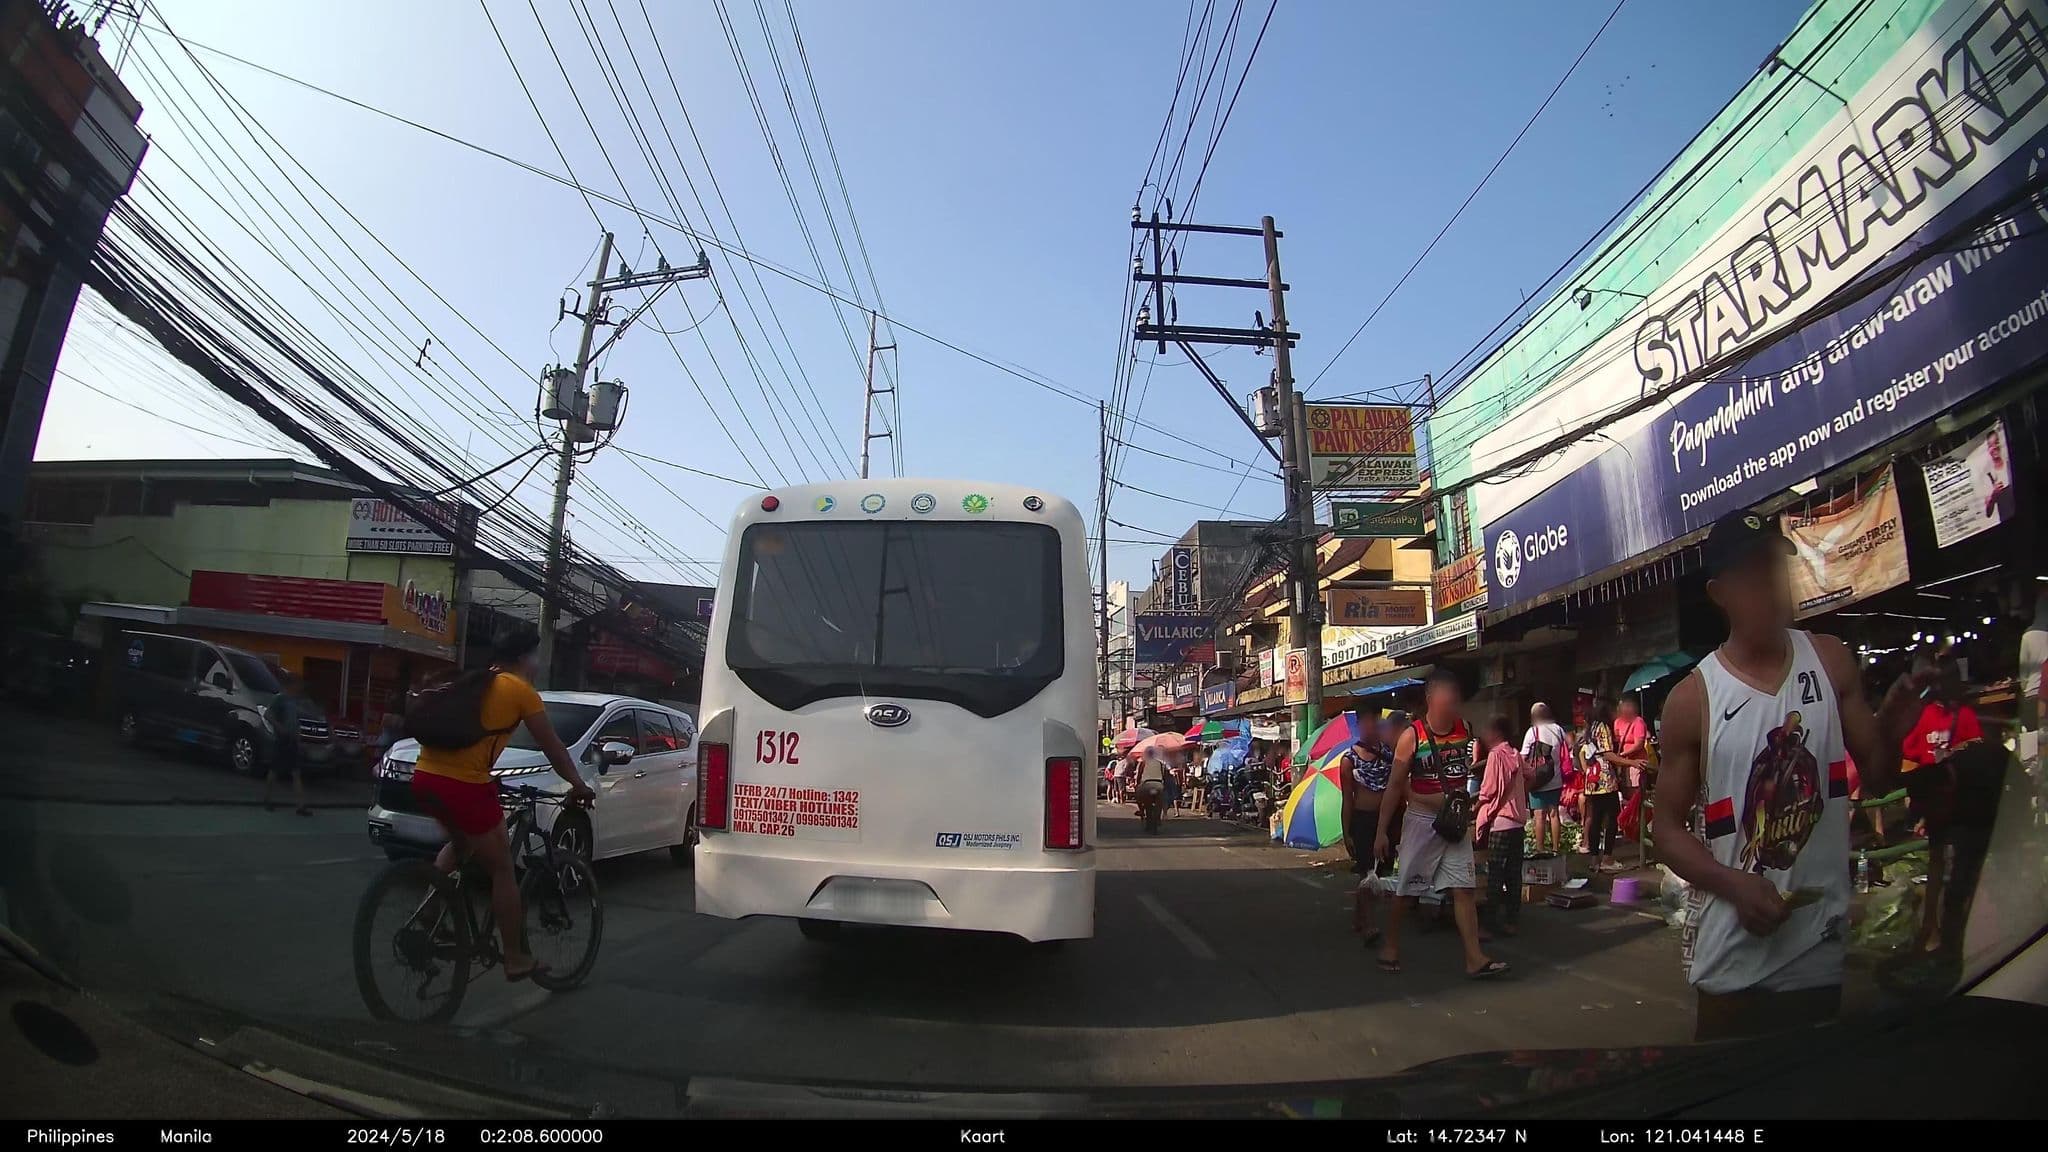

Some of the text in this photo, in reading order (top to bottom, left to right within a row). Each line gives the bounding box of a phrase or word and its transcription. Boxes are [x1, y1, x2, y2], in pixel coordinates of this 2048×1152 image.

[1670, 375, 1773, 473] Pagandahin
[1780, 351, 1825, 394] ang
[1827, 260, 1954, 364] araw-araw
[1330, 408, 1408, 431] PALAWAN
[1680, 465, 1742, 511] Download
[1743, 458, 1768, 480] the
[1769, 441, 1797, 468] app
[1799, 422, 1831, 452] now
[1833, 398, 1866, 433] and
[1866, 359, 1931, 412] register
[1931, 337, 1976, 384] your
[1312, 429, 1411, 453] PAWNSHOP
[1358, 468, 1413, 476] EXPRESS
[1866, 516, 1898, 542] FIREFLY
[388, 540, 407, 552] SLOTS
[433, 542, 450, 554] FREE
[1524, 524, 1568, 562] Globe
[1344, 599, 1379, 619] Ria
[1331, 647, 1354, 665] 0917
[1356, 639, 1377, 657] 708
[1798, 670, 1823, 705] 21
[756, 730, 800, 765] 1312
[734, 783, 859, 804] LTFRB 24/7 Hotline: 1342
[734, 796, 859, 816] TEXT/VIBER HOTLINES:
[733, 808, 788, 824] 09175501342
[796, 813, 858, 829] 09985501342
[733, 820, 758, 834] MAX.
[938, 834, 960, 846] QSJ
[974, 833, 996, 842] MOTORS
